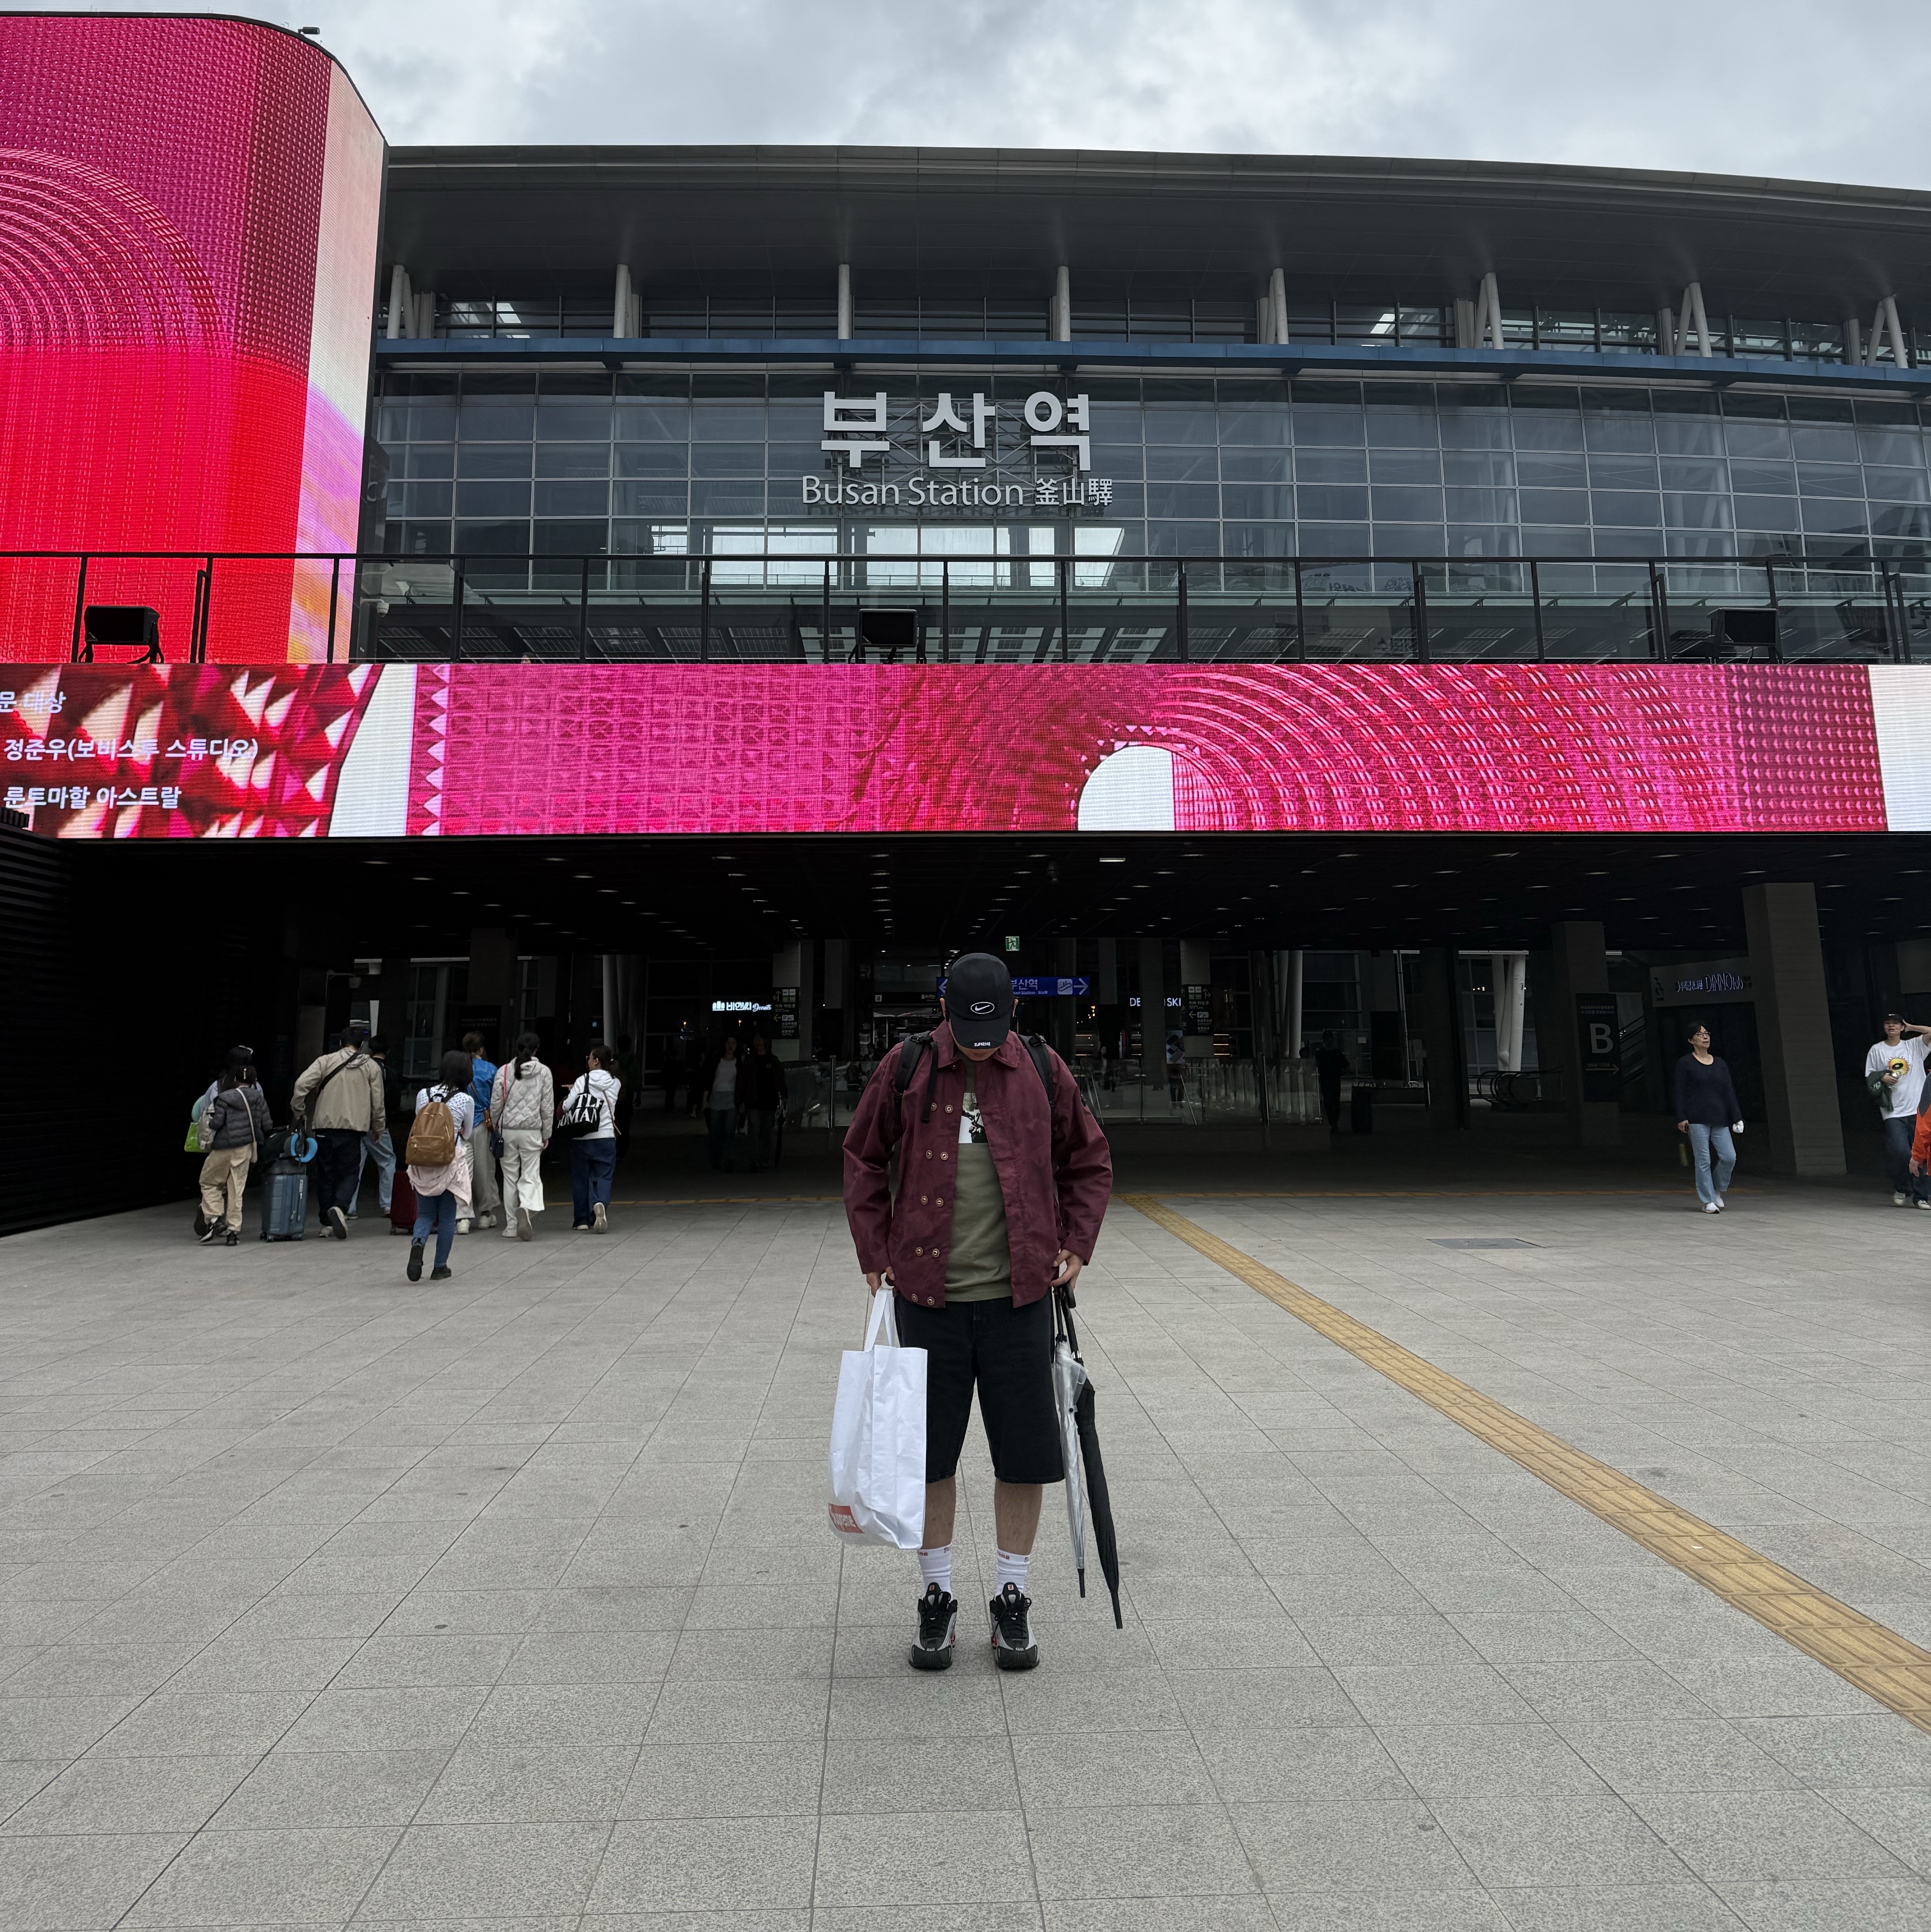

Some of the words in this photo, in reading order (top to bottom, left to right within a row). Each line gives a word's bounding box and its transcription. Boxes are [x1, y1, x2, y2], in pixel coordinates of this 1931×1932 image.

[821, 391, 1091, 471] 부산역
[802, 476, 900, 505] Busan
[908, 477, 1024, 506] Station
[1035, 478, 1113, 506] 釜山驛
[23, 691, 67, 713] 대상
[165, 738, 258, 761] 스튜디오)
[3, 786, 91, 809] 룬트마할
[96, 786, 182, 809] 아스트랄
[1590, 1023, 1614, 1054] B
